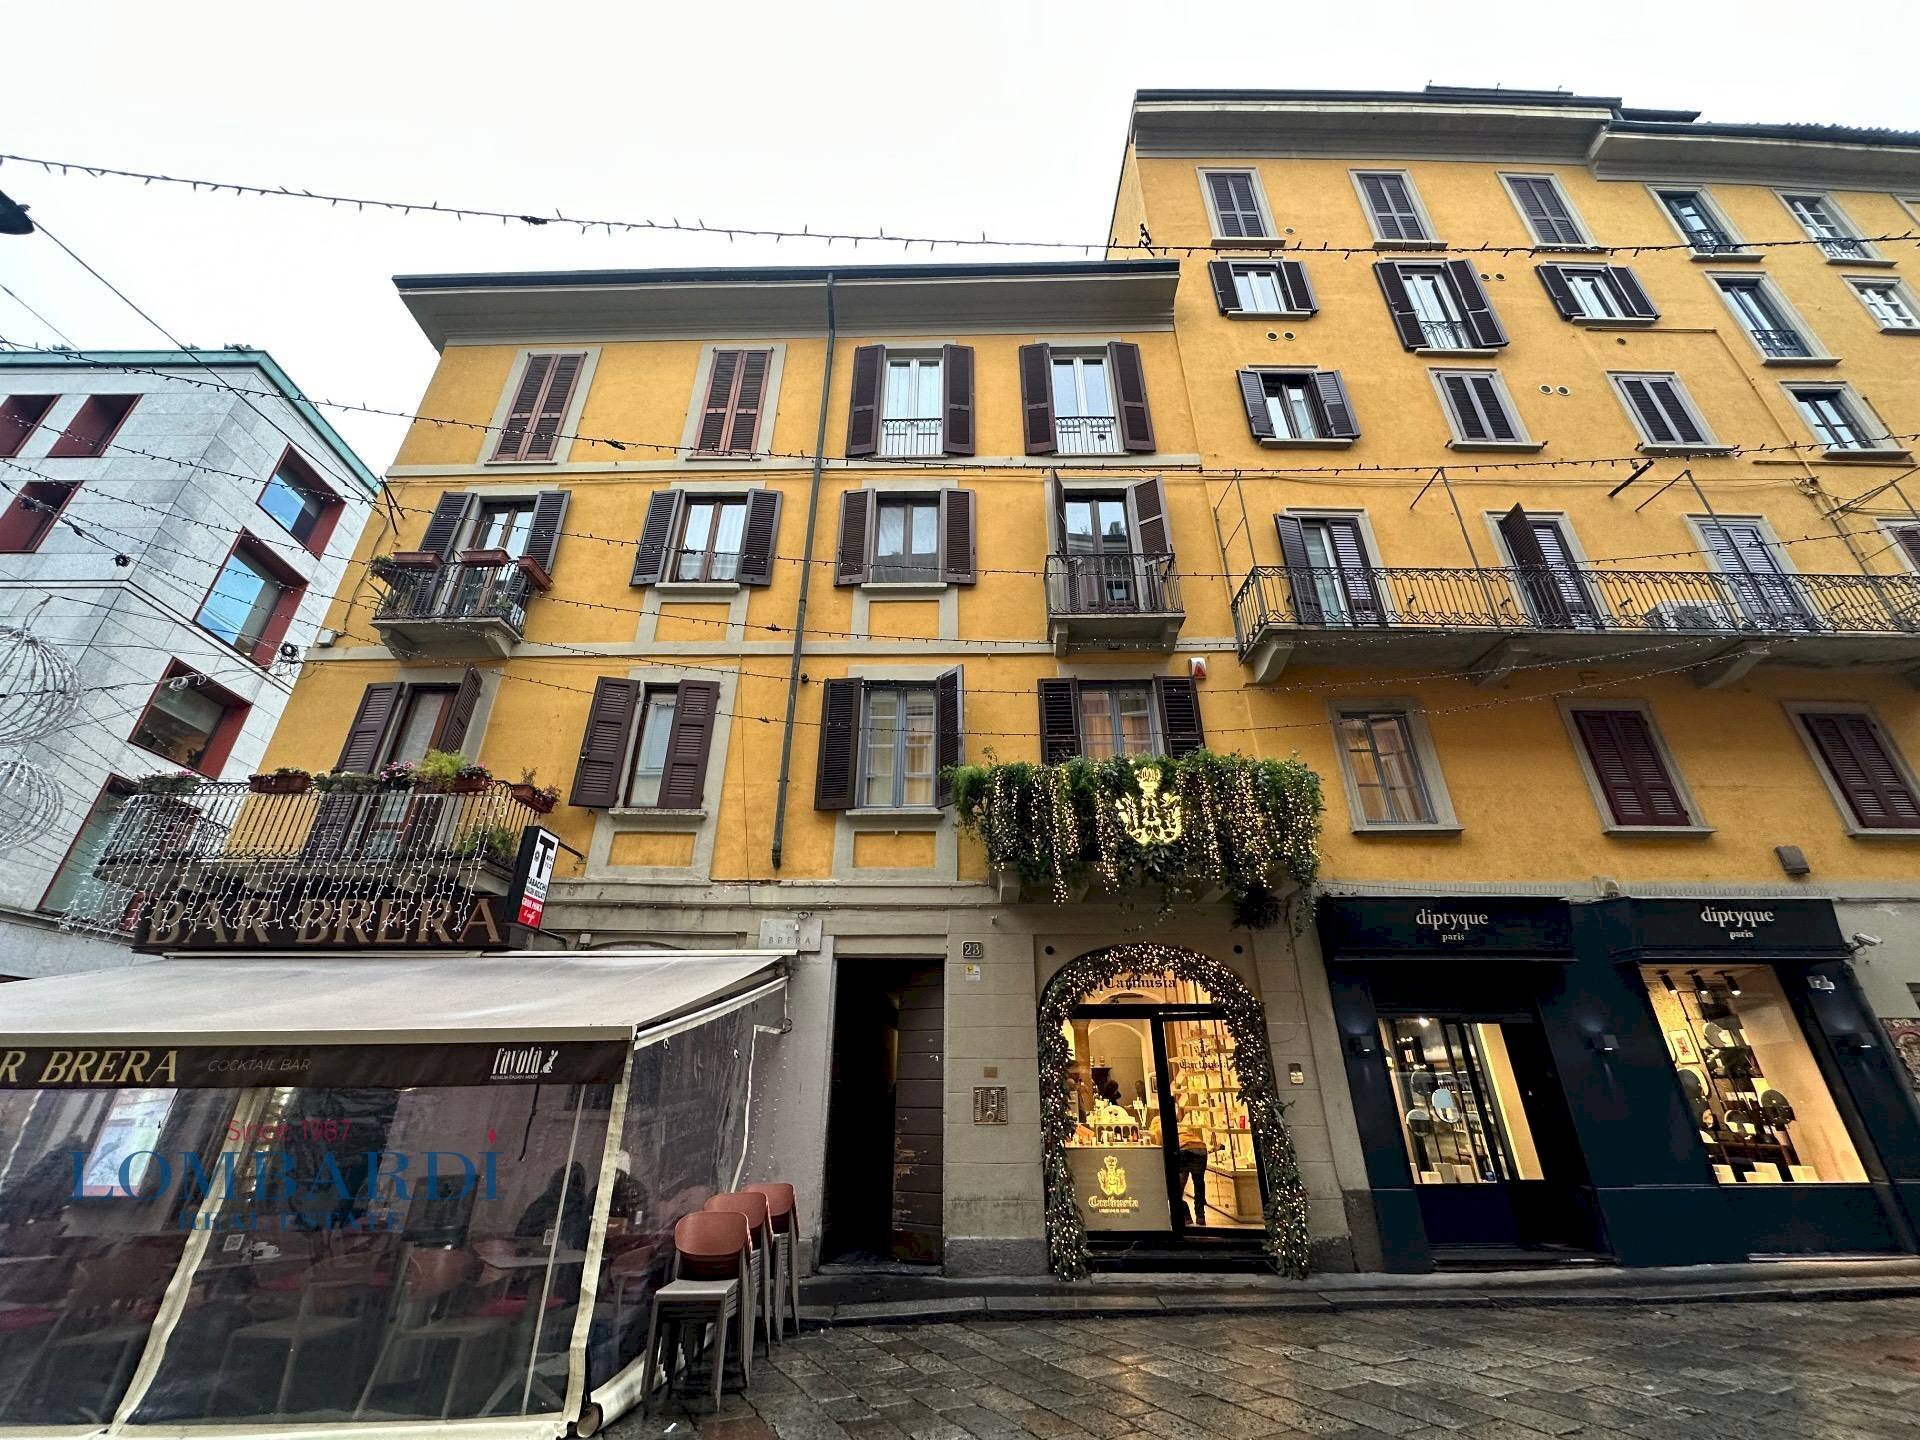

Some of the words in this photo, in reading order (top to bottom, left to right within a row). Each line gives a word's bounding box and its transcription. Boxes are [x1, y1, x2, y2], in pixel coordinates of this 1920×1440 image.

[146, 898, 271, 944] BAR
[295, 898, 501, 944] BRERA
[1415, 908, 1489, 930] diptyque
[1700, 906, 1775, 928] diptyque
[768, 936, 811, 944] BRERA
[1441, 932, 1465, 943] paris
[1729, 929, 1755, 940] paris
[38, 1050, 178, 1083] BRERA
[207, 1056, 275, 1073] COCKTAIL
[280, 1058, 312, 1072] BAR
